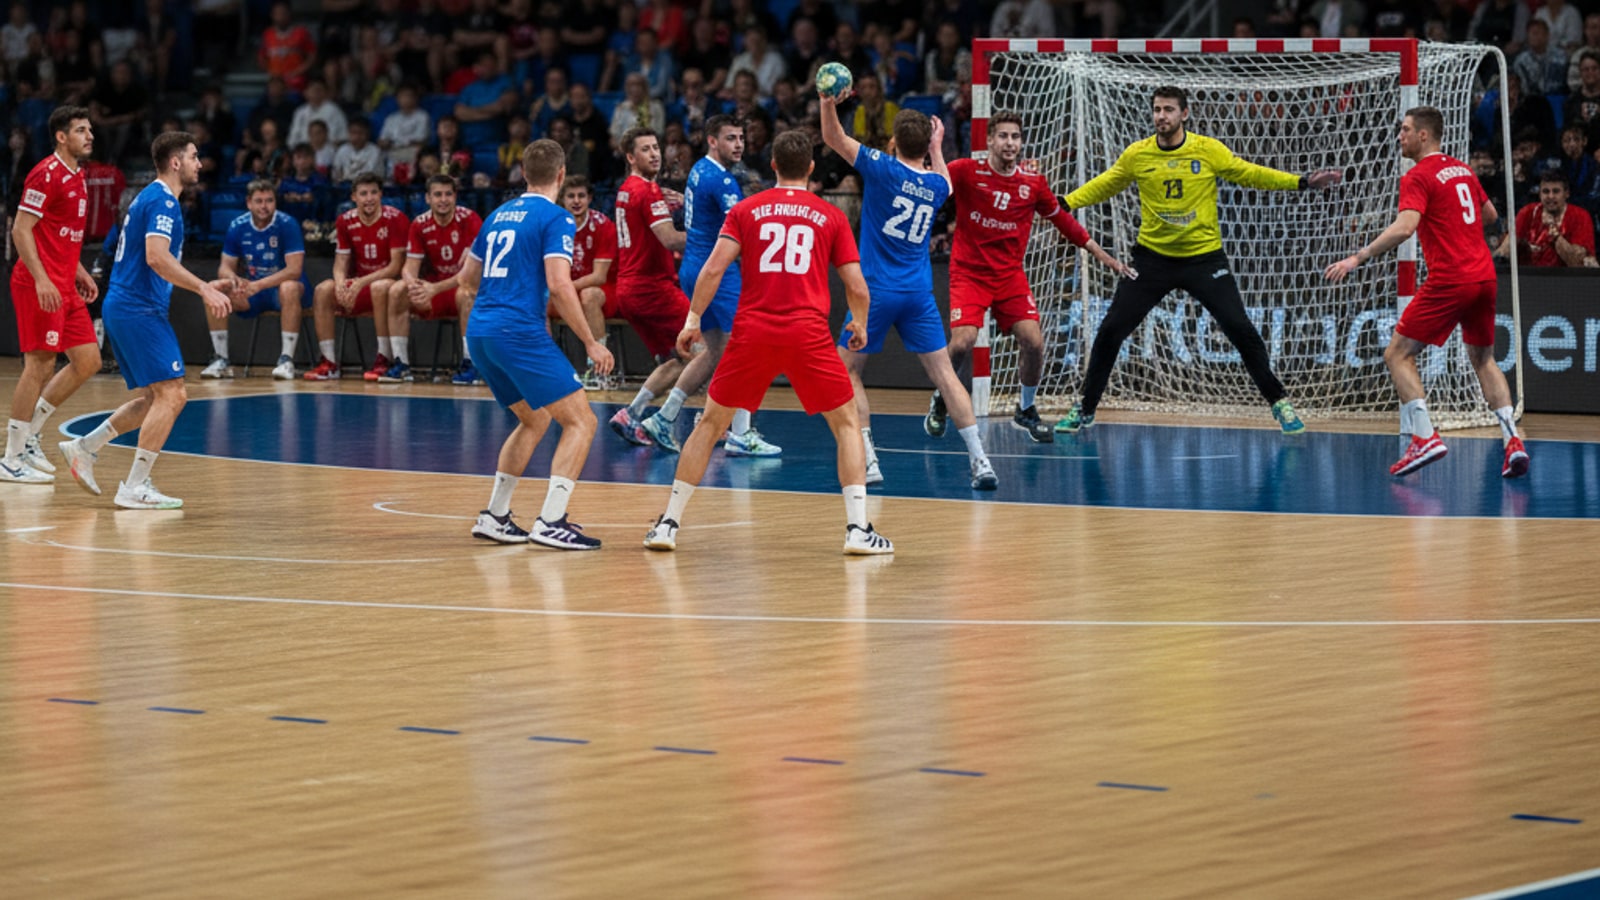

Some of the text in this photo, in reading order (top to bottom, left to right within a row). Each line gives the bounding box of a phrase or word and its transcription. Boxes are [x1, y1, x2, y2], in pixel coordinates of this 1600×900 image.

[882, 195, 934, 244] 20
[1455, 183, 1476, 225] 9
[483, 229, 516, 278] 12
[759, 222, 814, 275] 28
